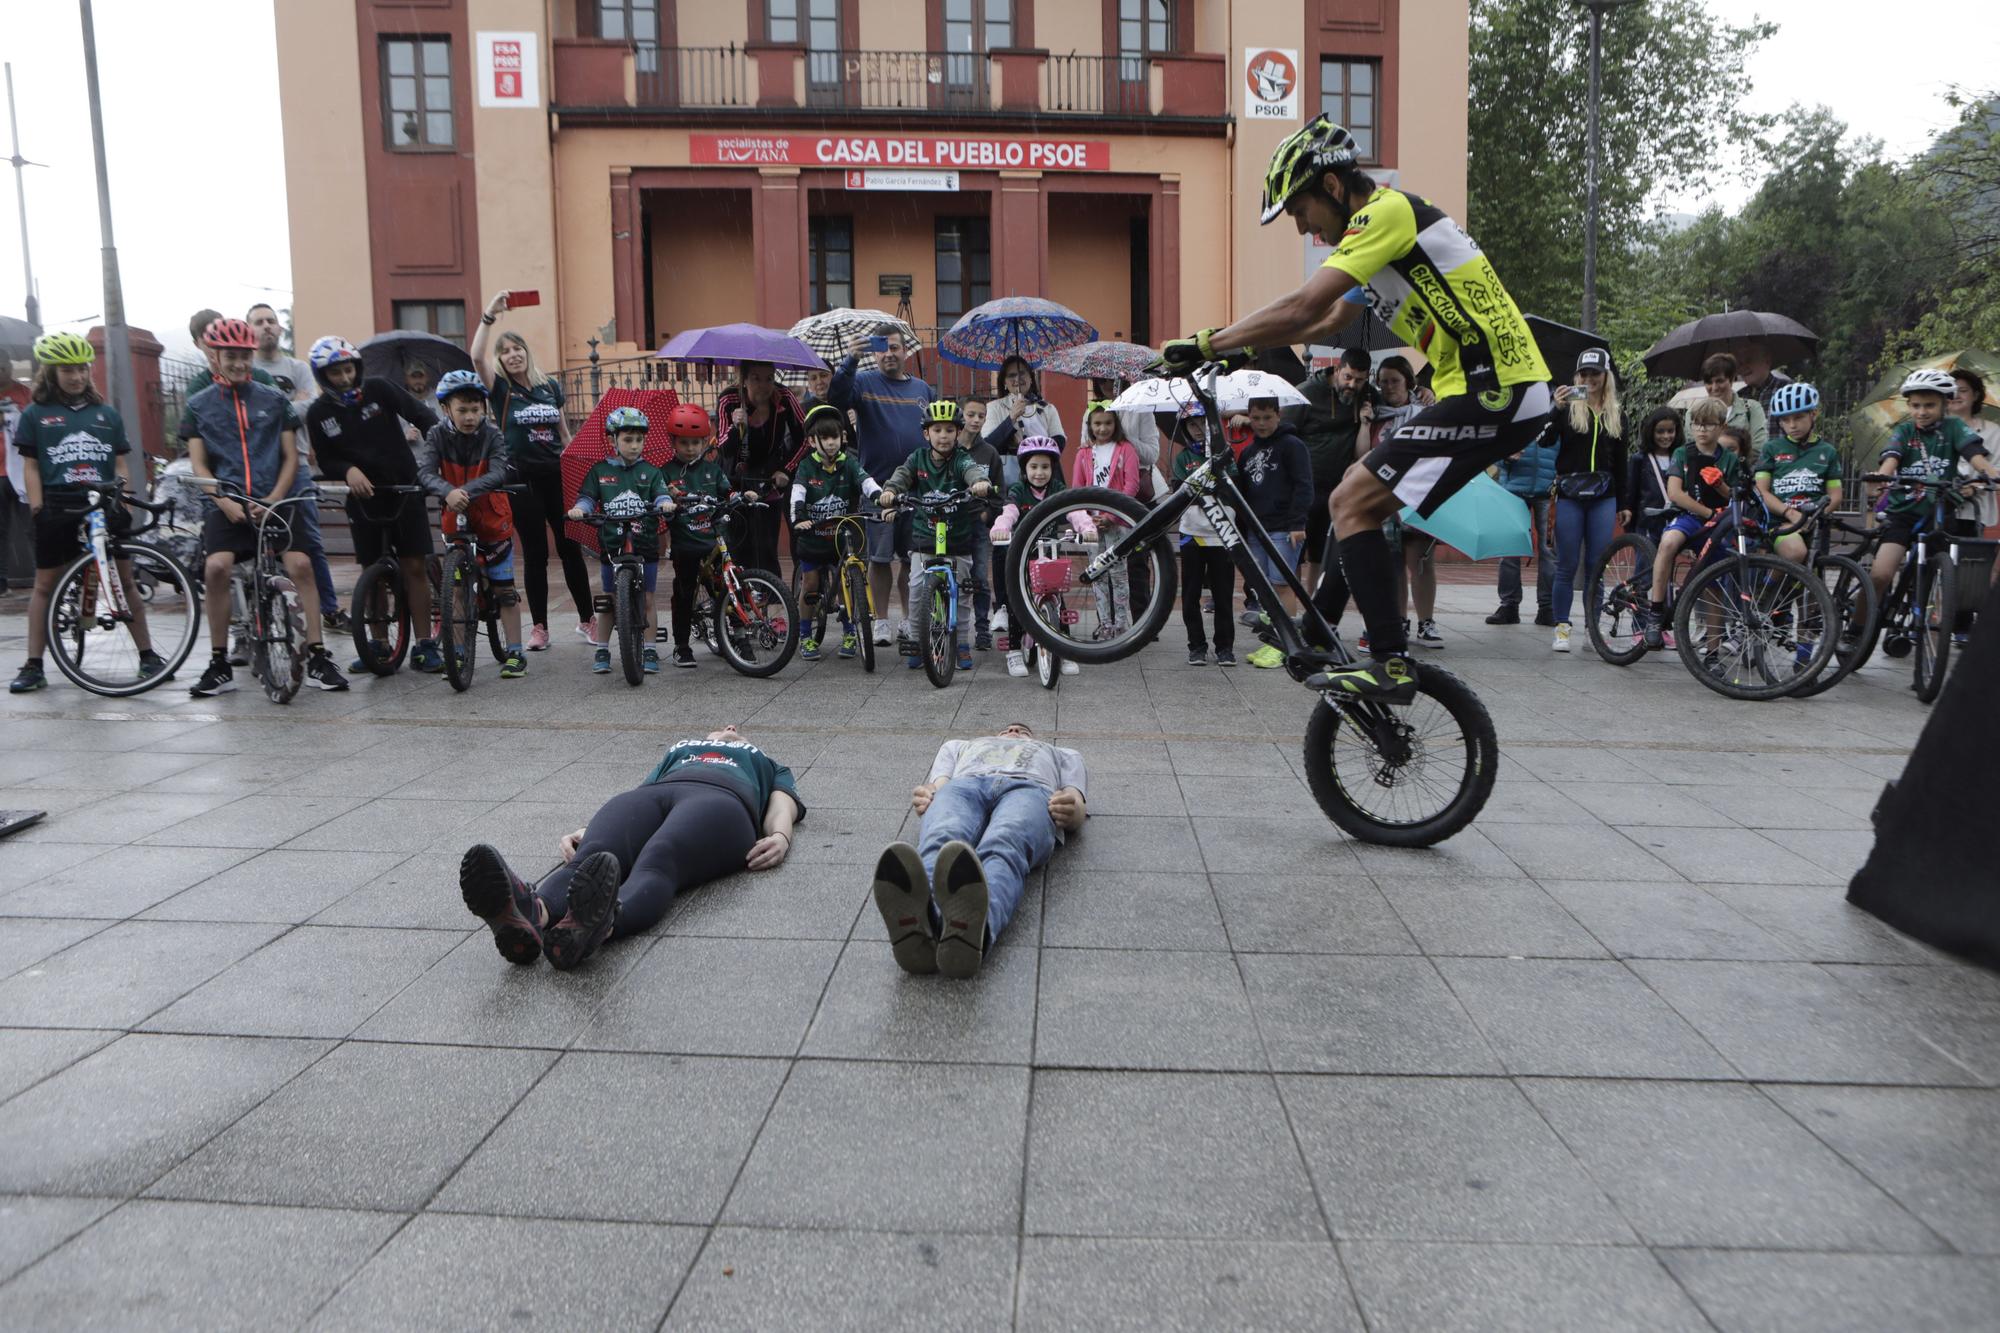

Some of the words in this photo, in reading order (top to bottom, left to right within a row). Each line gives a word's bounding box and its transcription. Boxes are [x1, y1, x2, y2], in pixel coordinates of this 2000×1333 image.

[1255, 104, 1288, 117] PSOE
[717, 137, 772, 150] socialistas
[775, 138, 789, 150] de
[816, 138, 882, 163] CASA
[887, 139, 930, 164] DEL
[935, 140, 1024, 166] PUEBLO
[1029, 142, 1087, 167] PSOE
[866, 175, 884, 185] Pablo
[1393, 425, 1499, 440] COMAS
[46, 442, 113, 456] senderos
[1206, 504, 1240, 548] RAW
